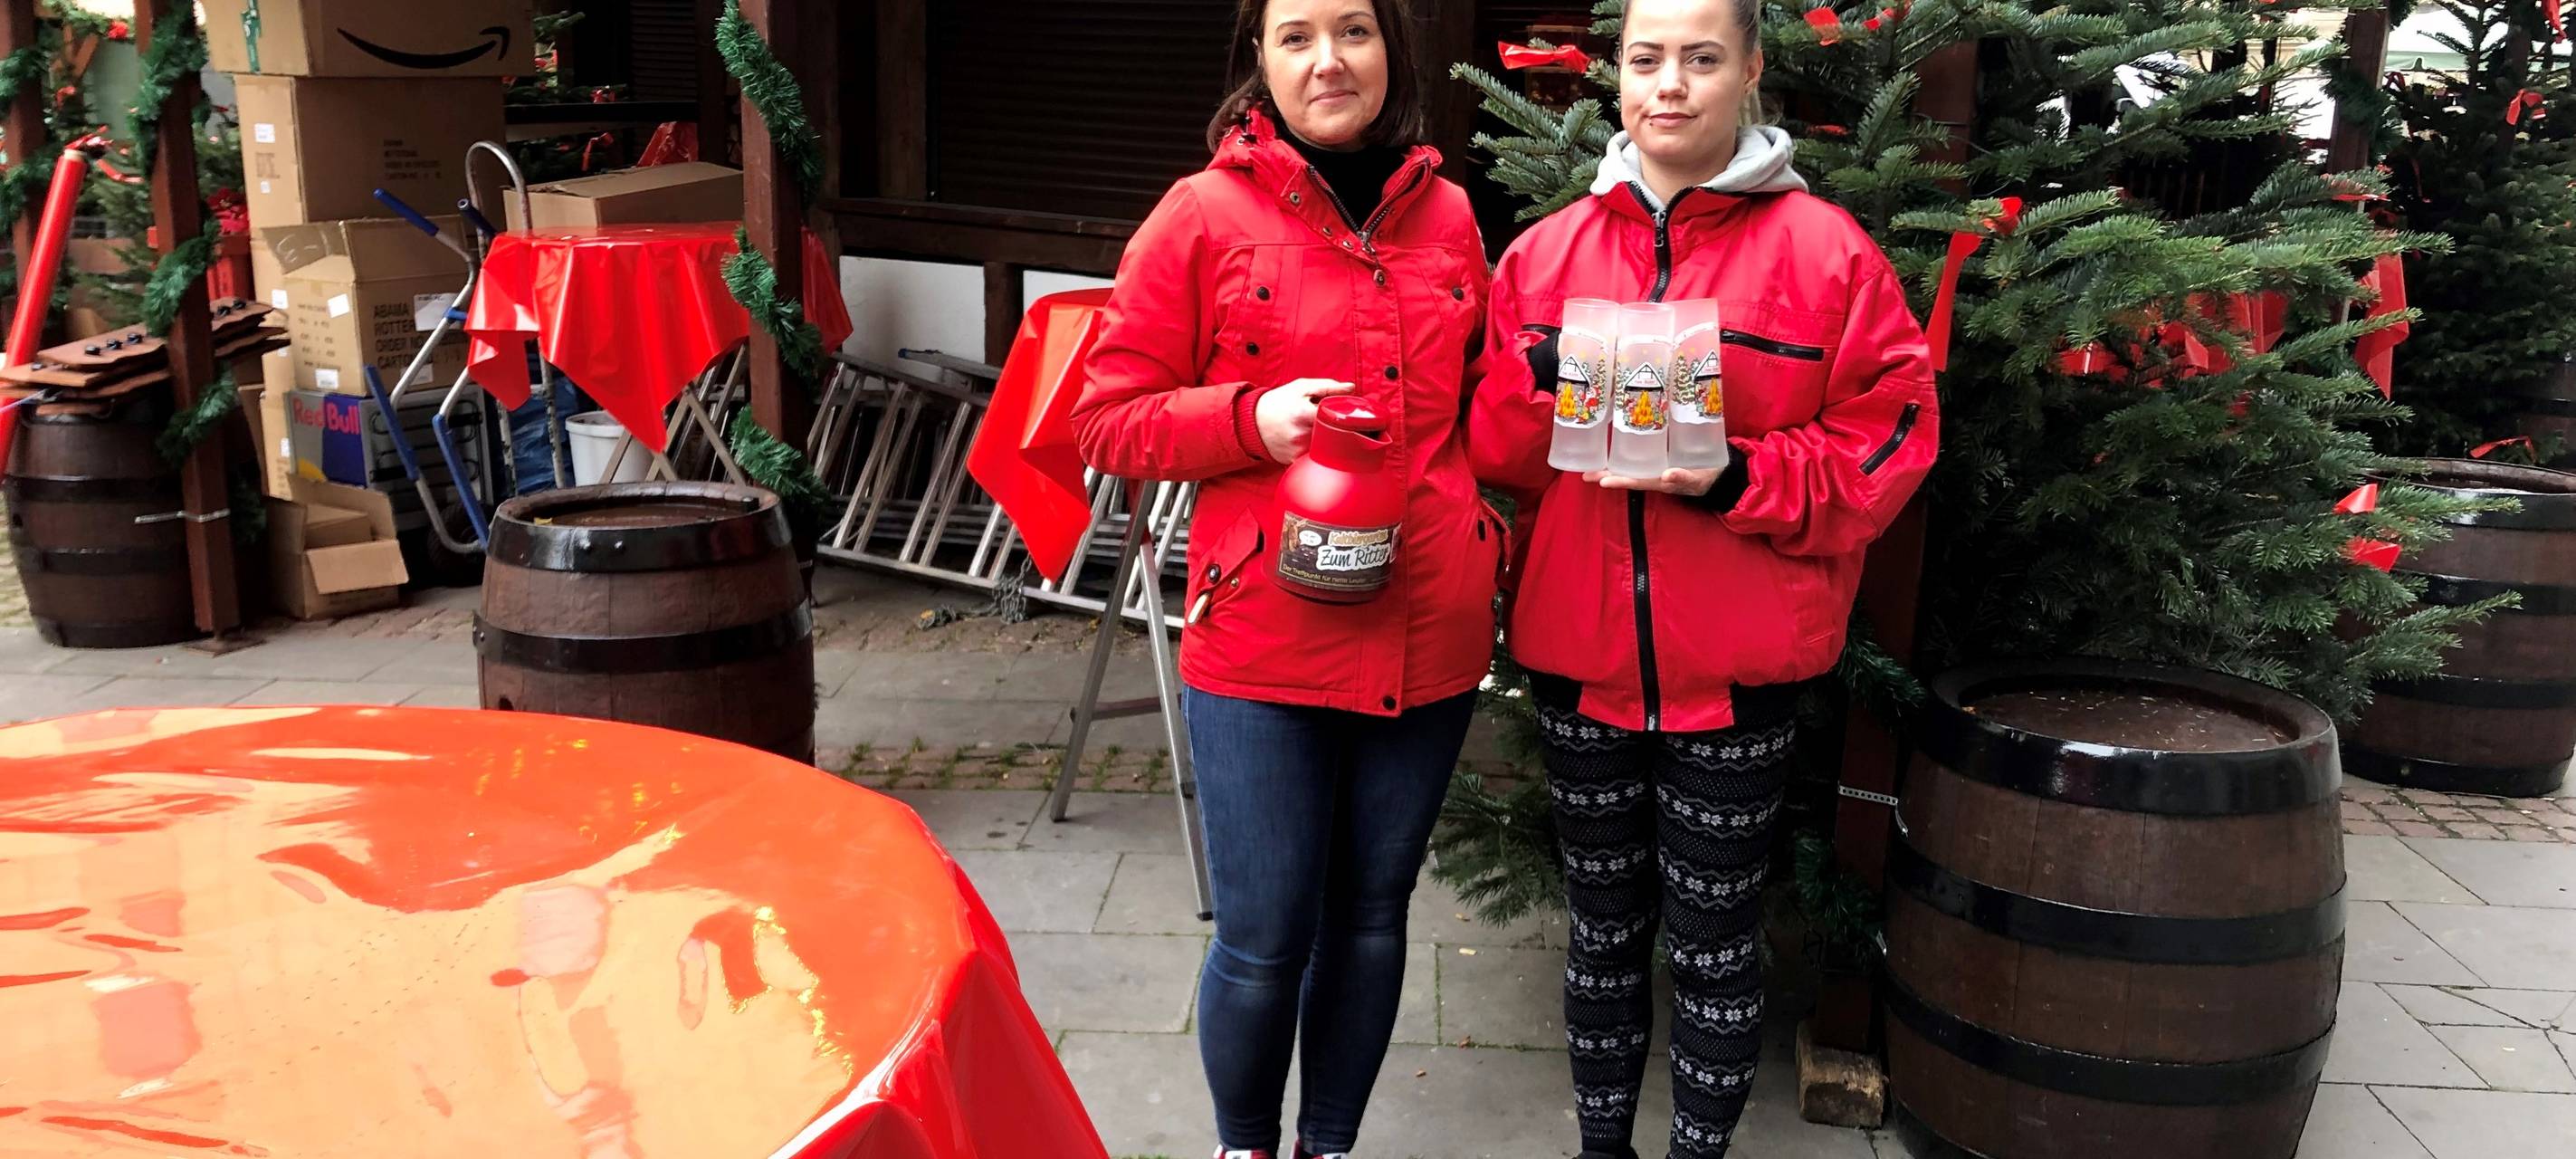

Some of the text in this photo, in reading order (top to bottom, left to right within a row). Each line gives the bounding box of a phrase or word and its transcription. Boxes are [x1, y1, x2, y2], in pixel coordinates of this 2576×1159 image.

[292, 397, 360, 435] Red Bull
[1321, 546, 1388, 567] Zum Ritter
[1283, 563, 1293, 572] Der
[1293, 567, 1321, 580] Treffpunkt
